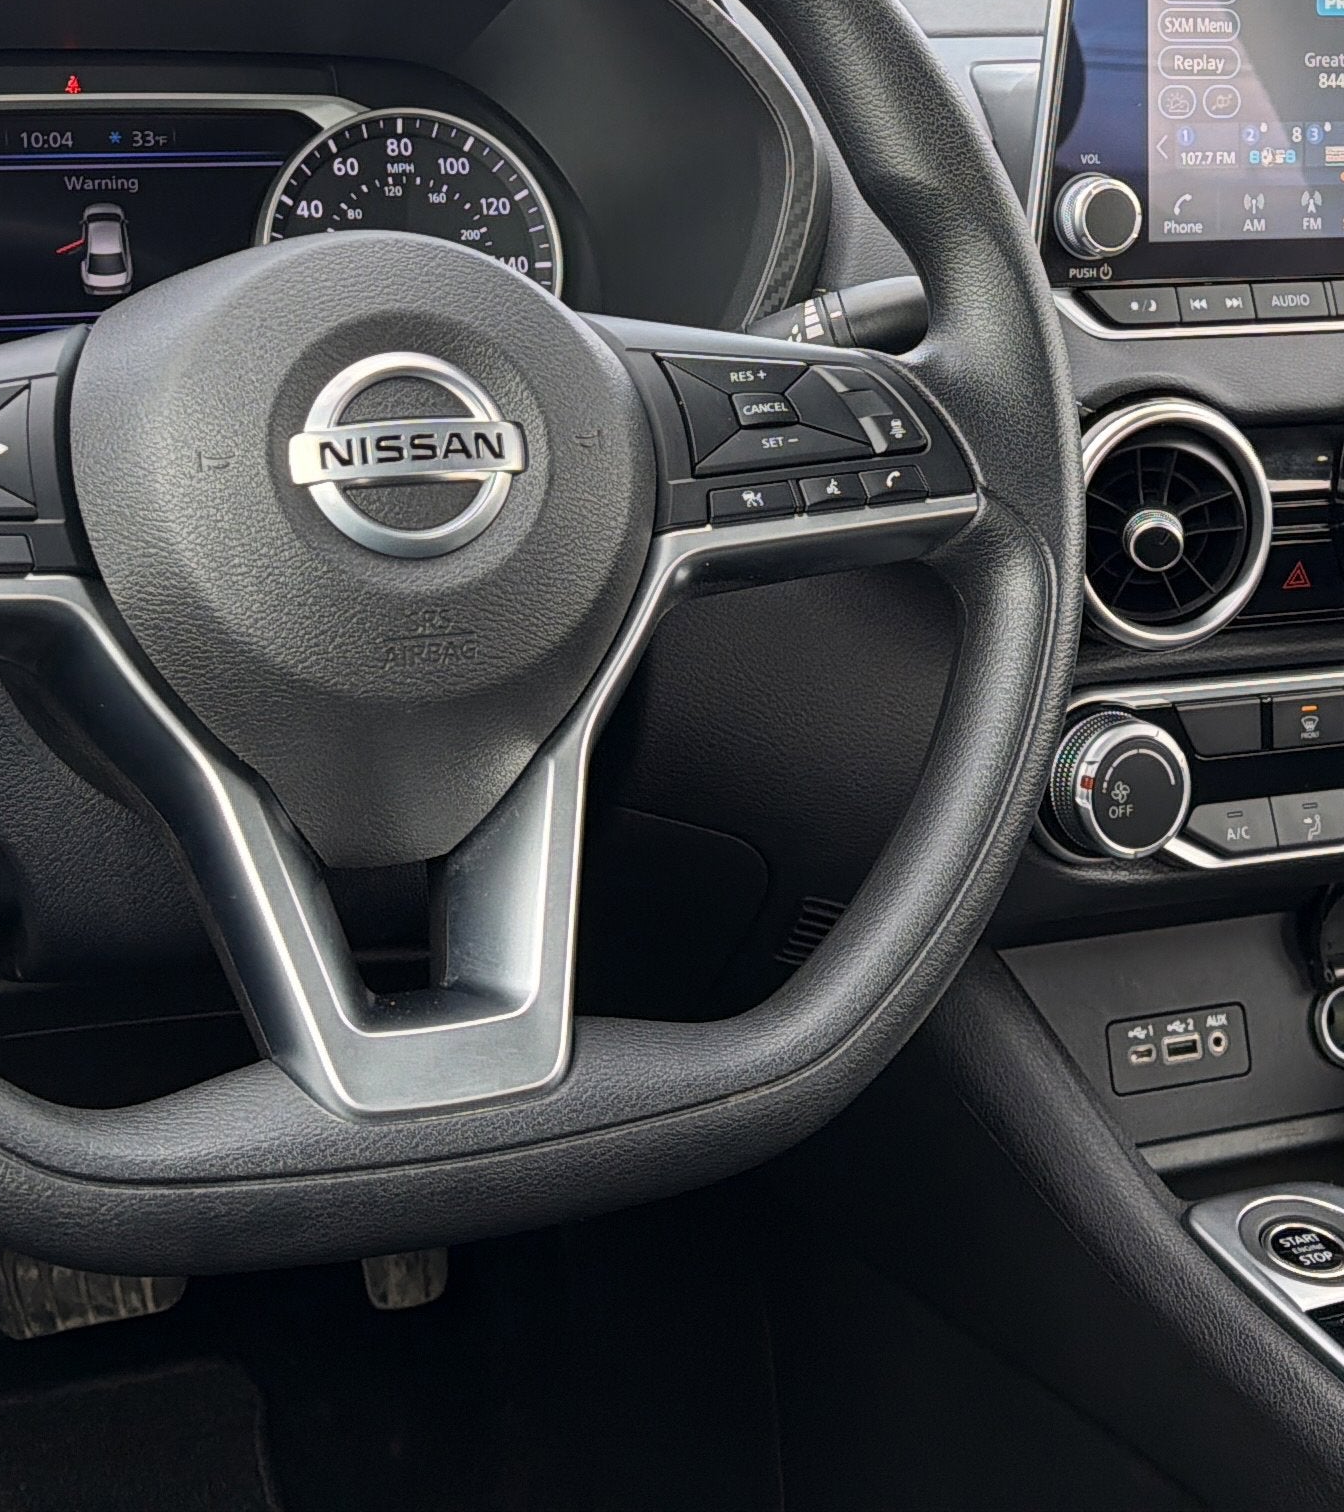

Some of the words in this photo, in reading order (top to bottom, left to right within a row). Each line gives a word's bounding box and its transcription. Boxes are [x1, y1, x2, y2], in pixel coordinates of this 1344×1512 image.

[1164, 17, 1194, 34] SXM
[1197, 17, 1233, 34] Menu
[1174, 55, 1225, 74] Replay
[19, 130, 73, 148] 10:04
[1181, 129, 1189, 141] 1
[1246, 128, 1255, 141] 2
[1291, 126, 1302, 143] 8
[1310, 128, 1319, 141] 3
[386, 138, 413, 156] 80
[1080, 153, 1101, 165] VOL
[1179, 151, 1214, 165] 107.7
[1216, 151, 1236, 165] FM
[332, 157, 359, 176] 60
[387, 163, 415, 174] MPH
[437, 157, 470, 175] 100
[63, 175, 139, 193] Warning
[384, 185, 403, 197] 120
[427, 192, 447, 204] 160
[296, 199, 323, 218] 40
[479, 197, 511, 216] 120
[346, 208, 363, 220] 80
[1163, 220, 1203, 234] Phone
[1242, 218, 1266, 232] AM
[1302, 217, 1322, 230] FM
[460, 229, 481, 241] 200
[1068, 266, 1097, 280] PUSH
[1271, 294, 1311, 307] AUDIO
[730, 370, 755, 383] RES
[742, 401, 789, 416] CANCEL
[761, 437, 785, 449] SET
[318, 431, 505, 470] NISSAN
[1108, 803, 1135, 819] OFF
[1226, 824, 1251, 841] A/C
[1186, 1018, 1194, 1031] 2
[1206, 1013, 1228, 1027] AUX
[1147, 1024, 1154, 1037] 1
[1279, 1233, 1320, 1248] START
[1299, 1250, 1333, 1266] STOP
